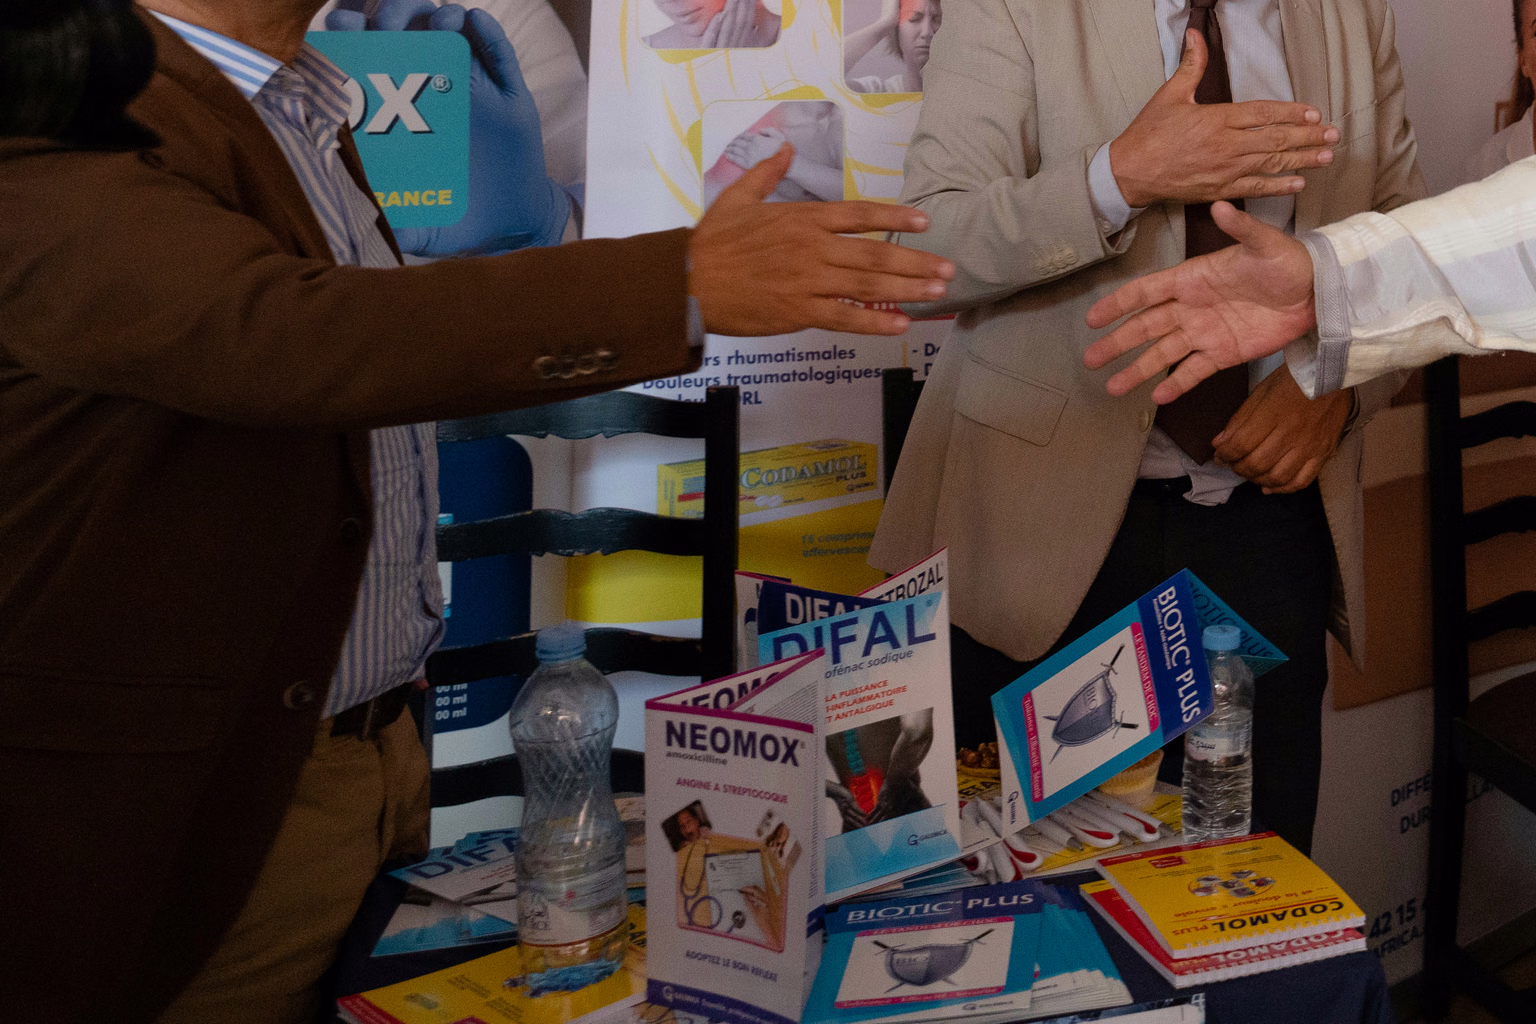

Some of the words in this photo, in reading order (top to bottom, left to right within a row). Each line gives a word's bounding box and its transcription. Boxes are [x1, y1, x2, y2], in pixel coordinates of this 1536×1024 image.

[727, 345, 856, 366] rhumatismales
[727, 365, 883, 385] traumatologiques
[872, 563, 943, 602] TROZAL
[785, 592, 861, 624] DIFA
[773, 604, 936, 665] DIFAL
[867, 650, 914, 668] sodique
[1157, 585, 1191, 667] BIOTIC
[1176, 668, 1200, 723] PLUS
[839, 679, 889, 697] PUISSANCE
[835, 699, 895, 721] ANTALGIQUE
[666, 720, 799, 767] NEOMOX
[666, 751, 728, 766] amoxicilline
[847, 900, 953, 923] BIOTIC
[967, 893, 1035, 910] PLUS
[1212, 901, 1344, 932] CODAMOL
